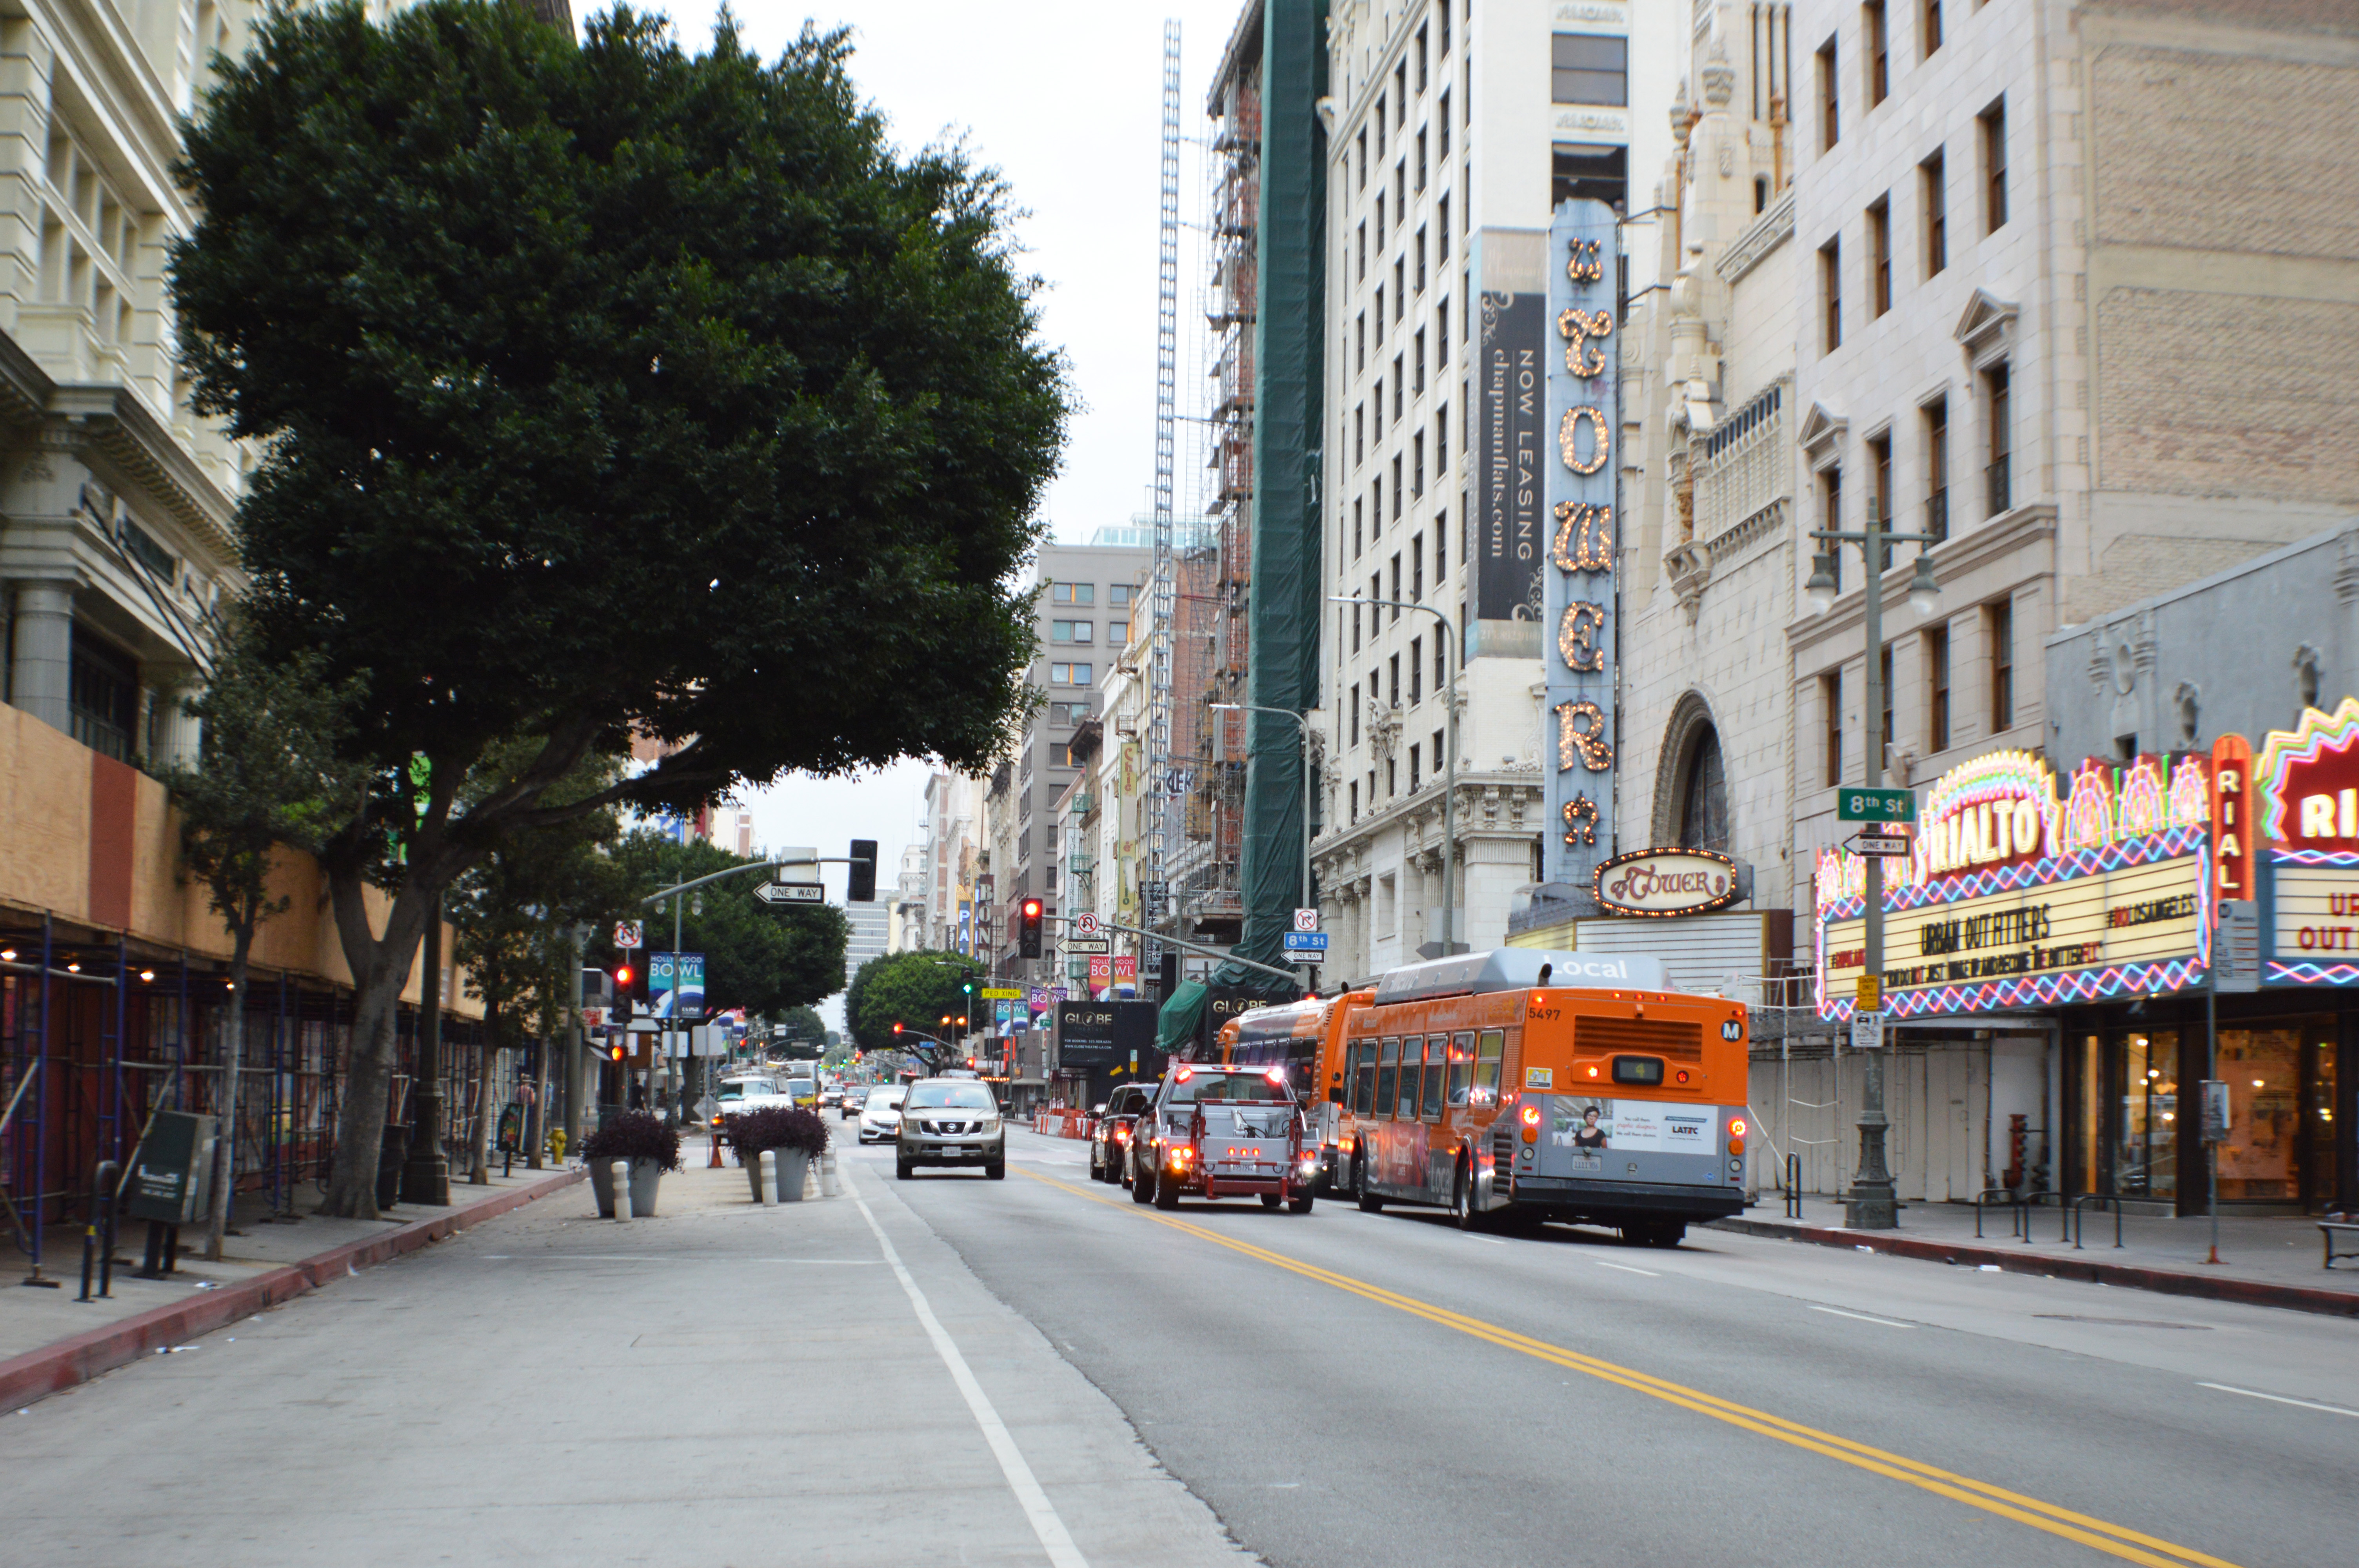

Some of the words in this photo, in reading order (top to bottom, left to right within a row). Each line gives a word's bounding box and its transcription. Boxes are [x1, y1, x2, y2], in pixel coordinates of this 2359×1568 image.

[1519, 349, 1534, 414] NOW
[1488, 348, 1510, 557] chapmanflats.com
[1518, 431, 1533, 560] LEASING
[1553, 307, 1614, 773] TOWER
[1850, 795, 1880, 813] 8th
[1885, 799, 1904, 813] St
[2301, 788, 2359, 838] RI
[1930, 798, 2039, 873] RIALTO
[2218, 769, 2242, 900] RIAL
[1862, 840, 1880, 849] ONE
[1885, 840, 1904, 849] WAY
[1610, 864, 1725, 900] TOWER
[771, 887, 790, 897] ONE
[797, 888, 818, 898] WAY
[1921, 918, 1961, 956] URBAN
[1965, 902, 2051, 950] OUTFITTERS
[1289, 935, 1307, 946] 8th
[1312, 936, 1324, 946] St
[650, 963, 702, 978] BOWL
[1091, 965, 1133, 976] BOWL
[1543, 954, 1628, 979] Local
[1032, 994, 1063, 1003] BOW
[997, 1005, 1027, 1013] BOWL
[1529, 1007, 1561, 1020] 5497
[1065, 1012, 1112, 1026] GLOBE
[1672, 1125, 1698, 1135] LATTC
